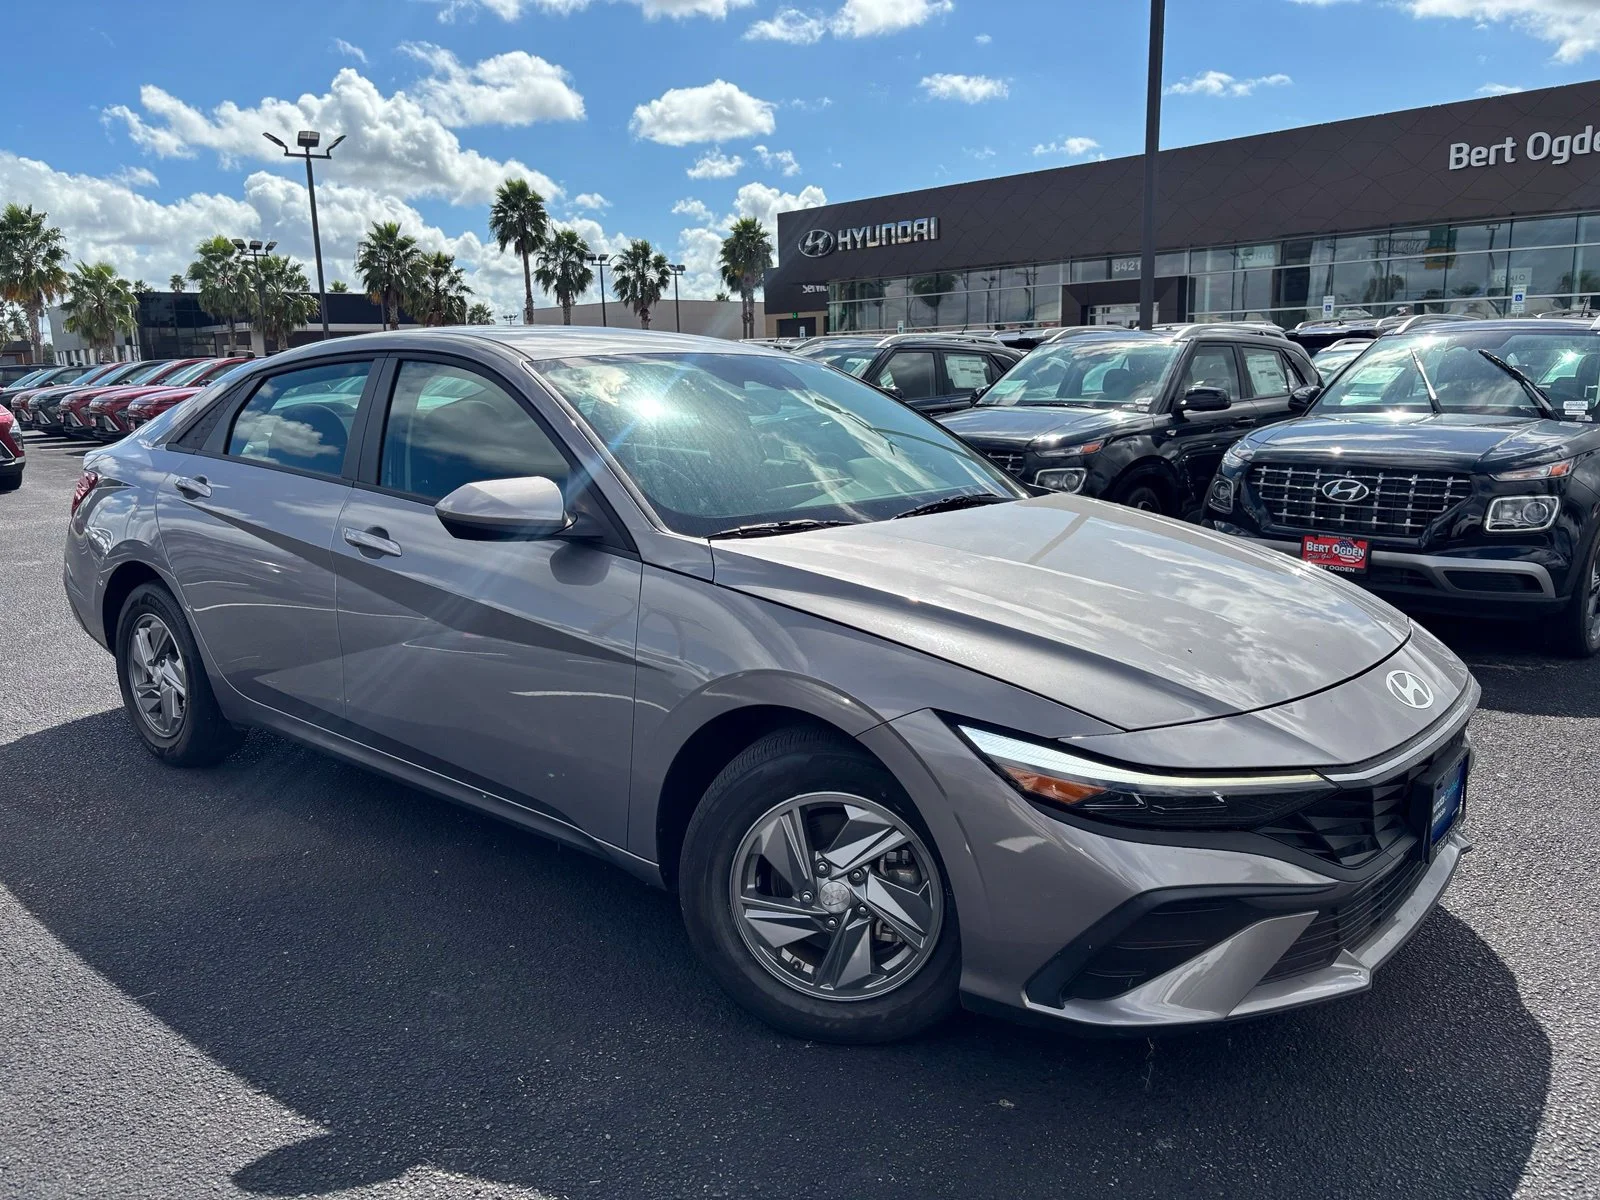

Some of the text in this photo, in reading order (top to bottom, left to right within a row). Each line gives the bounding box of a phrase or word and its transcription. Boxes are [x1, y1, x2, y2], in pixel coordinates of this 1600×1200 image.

[1449, 136, 1517, 170] Bert
[838, 216, 939, 251] HYUNDAI
[1114, 260, 1141, 271] 8421
[1306, 541, 1365, 557] BERT OGDEN
